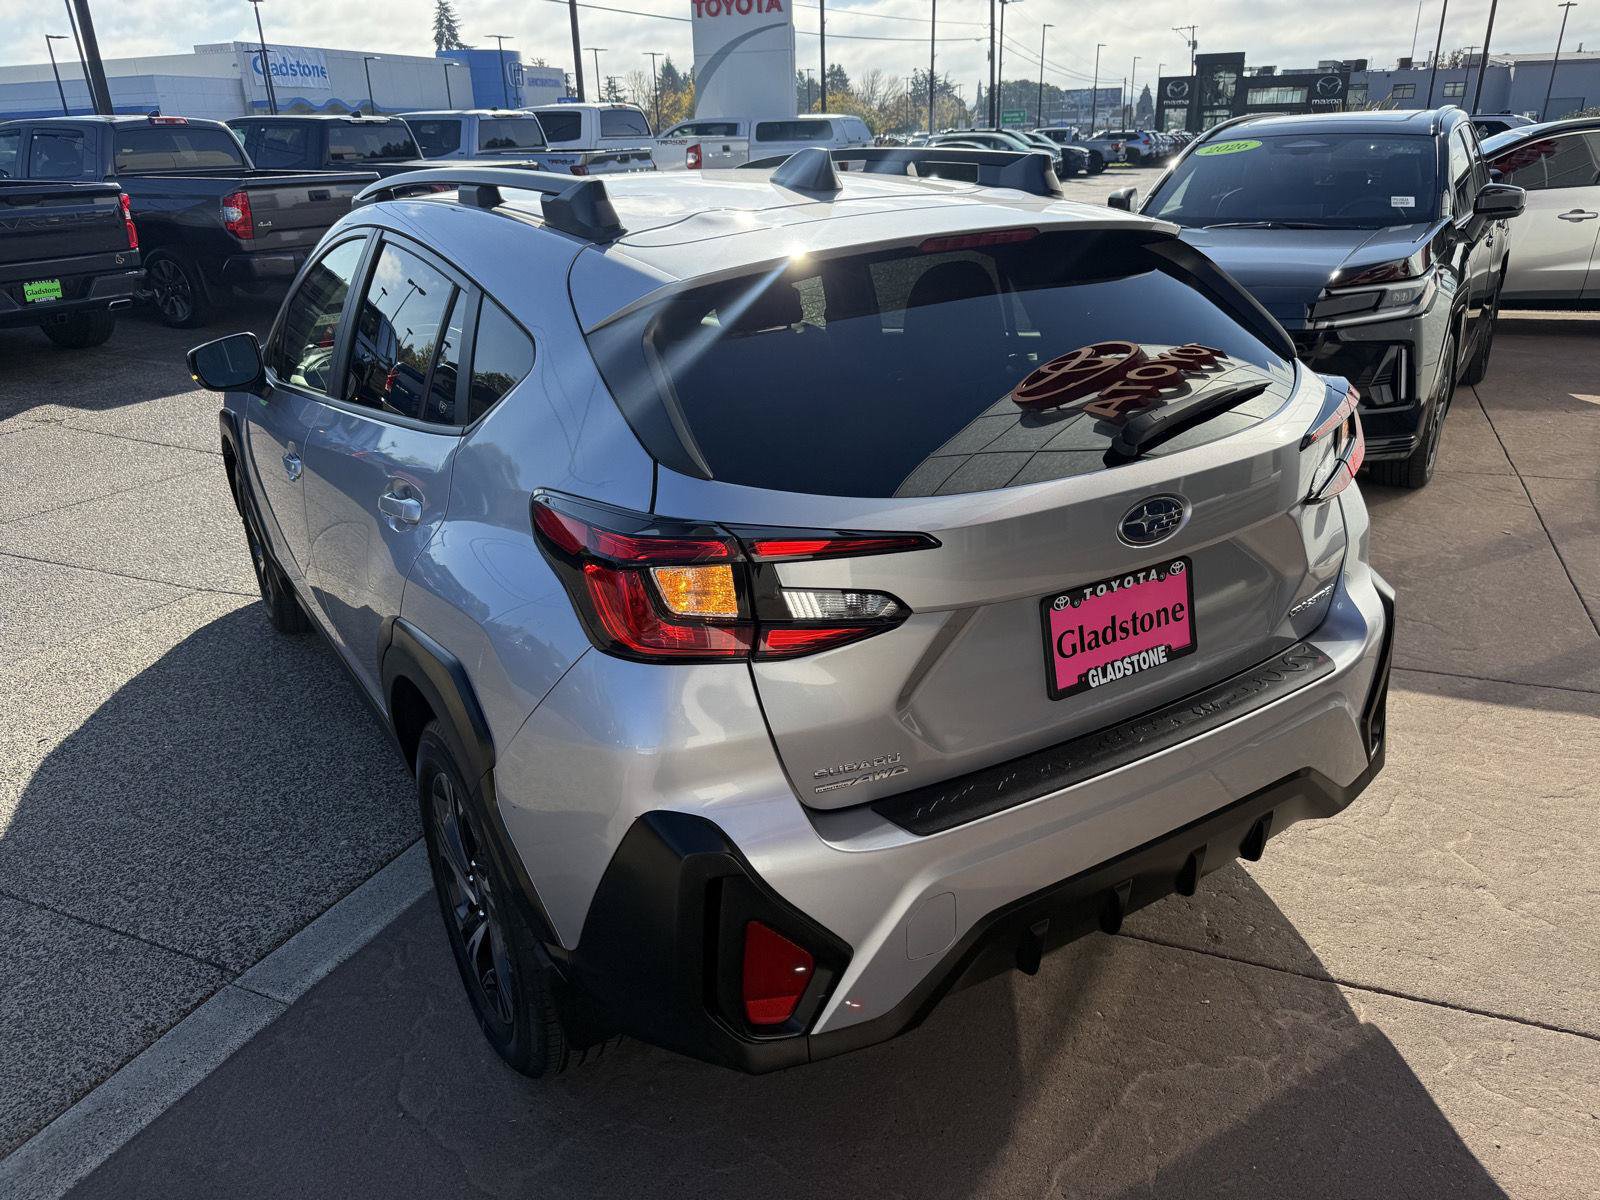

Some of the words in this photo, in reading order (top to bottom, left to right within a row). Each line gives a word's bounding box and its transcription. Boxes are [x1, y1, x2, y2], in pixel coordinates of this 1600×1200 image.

[692, 0, 782, 17] TOYOTA
[252, 54, 327, 79] Gadstone
[26, 287, 60, 296] Gladstone
[1084, 569, 1158, 600] TOYOTA
[1056, 602, 1185, 659] Gladstone
[1088, 645, 1168, 688] GLADSTONE
[813, 752, 901, 779] SUBARU
